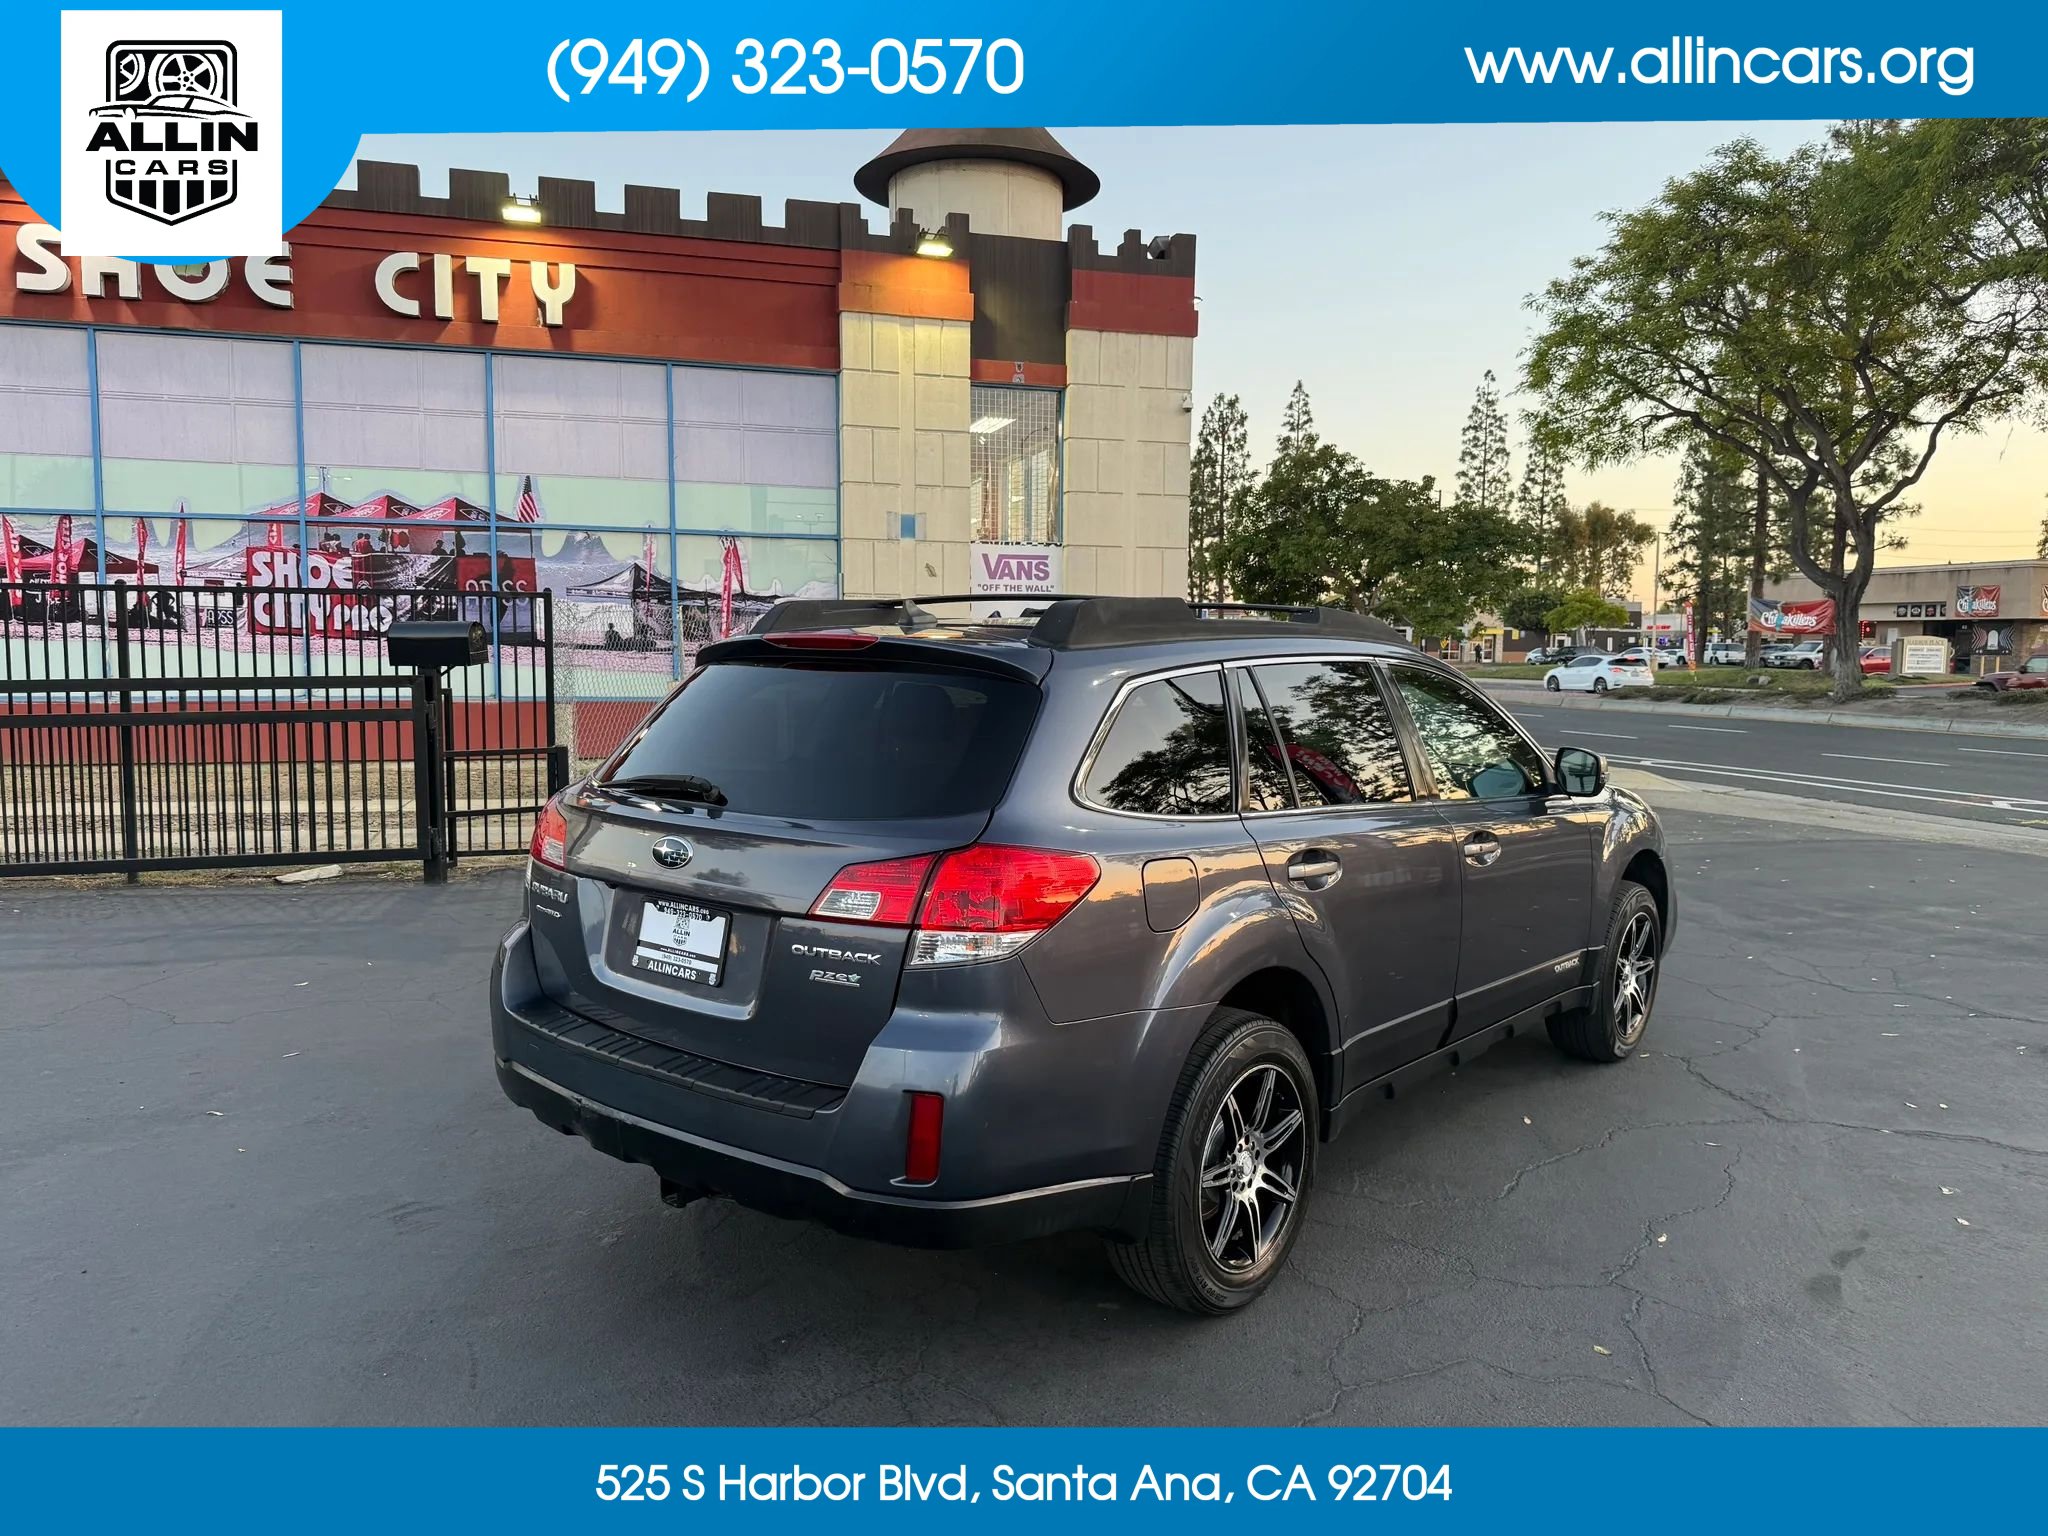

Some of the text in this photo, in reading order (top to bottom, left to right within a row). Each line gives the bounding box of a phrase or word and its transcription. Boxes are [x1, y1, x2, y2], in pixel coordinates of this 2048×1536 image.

[16, 223, 576, 327] SHOE CITY
[252, 551, 353, 589] SHOE
[981, 553, 1050, 582] VANS
[977, 584, 1001, 592] "OFF
[1025, 585, 1055, 593] WALL"
[672, 928, 691, 937] ALLIN
[791, 944, 882, 966] OUTBACK
[647, 960, 697, 981] ALLINCARS
